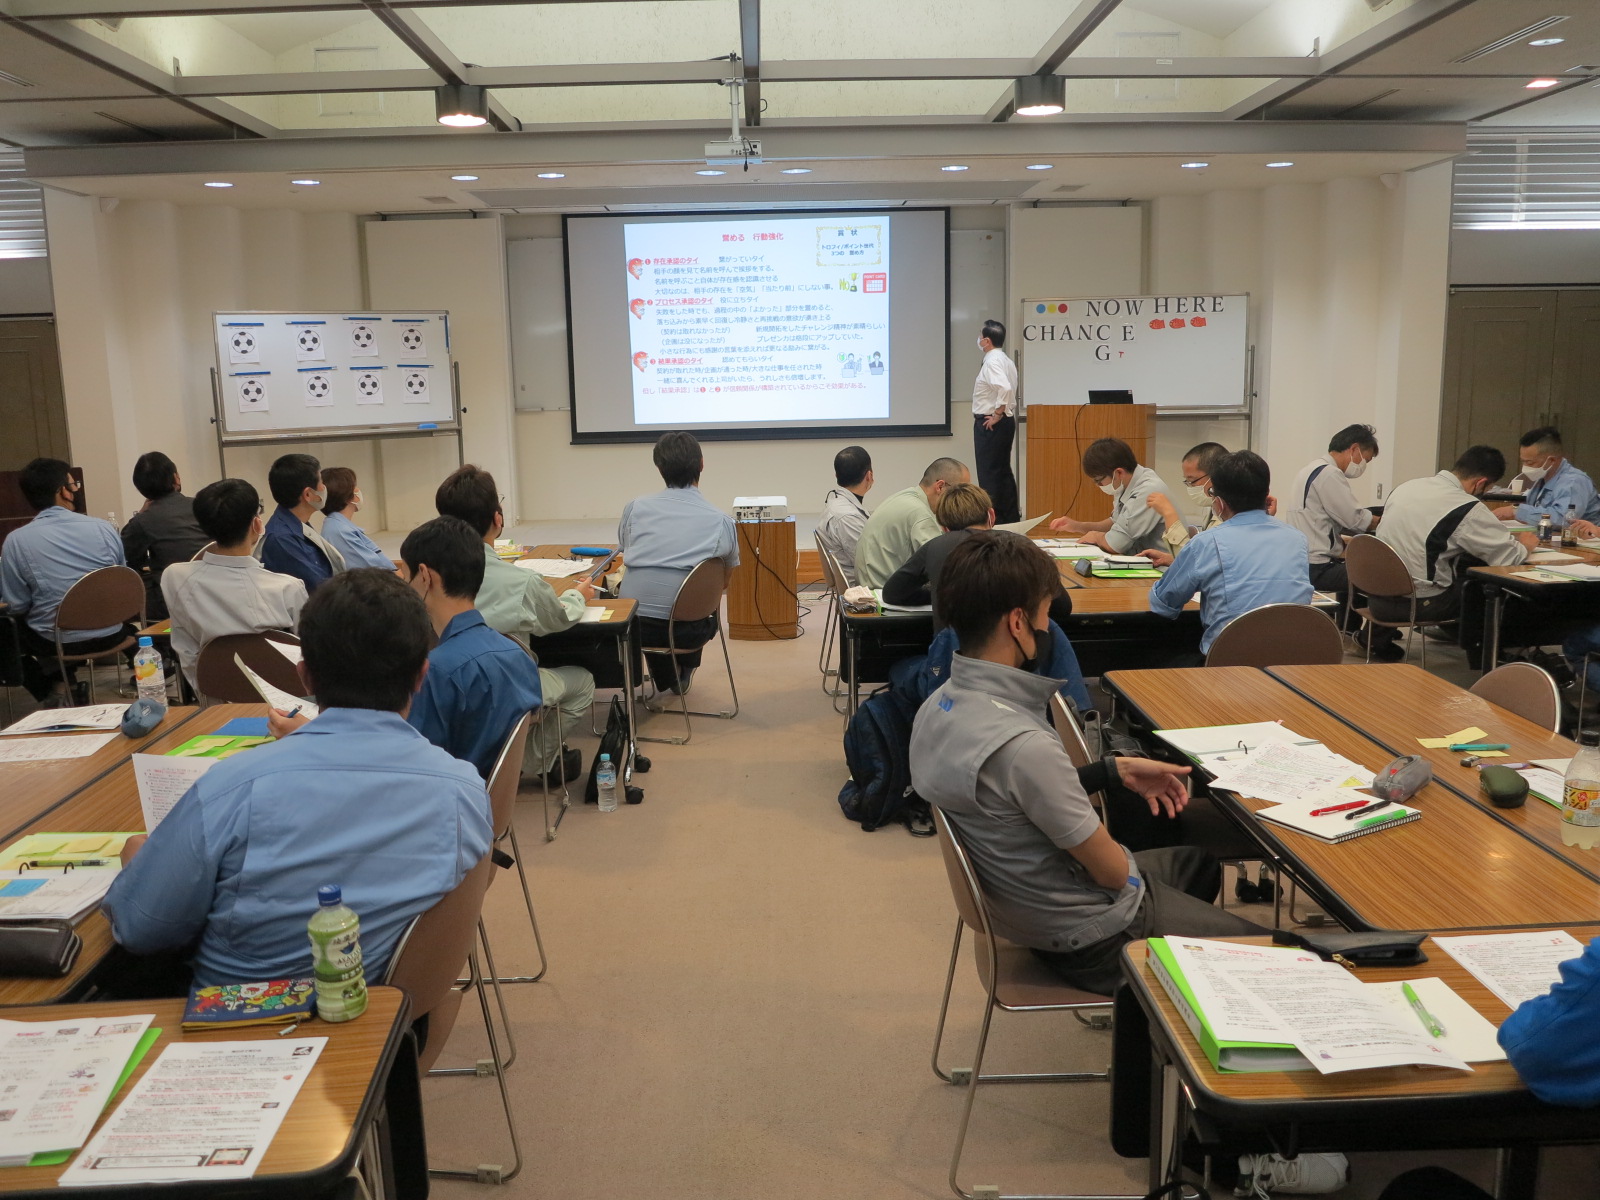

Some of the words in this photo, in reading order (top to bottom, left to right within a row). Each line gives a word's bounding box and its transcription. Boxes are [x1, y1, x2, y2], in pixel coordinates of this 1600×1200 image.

[1086, 299, 1145, 317] NOW
[1154, 296, 1225, 314] HERE
[1095, 345, 1111, 361] G
